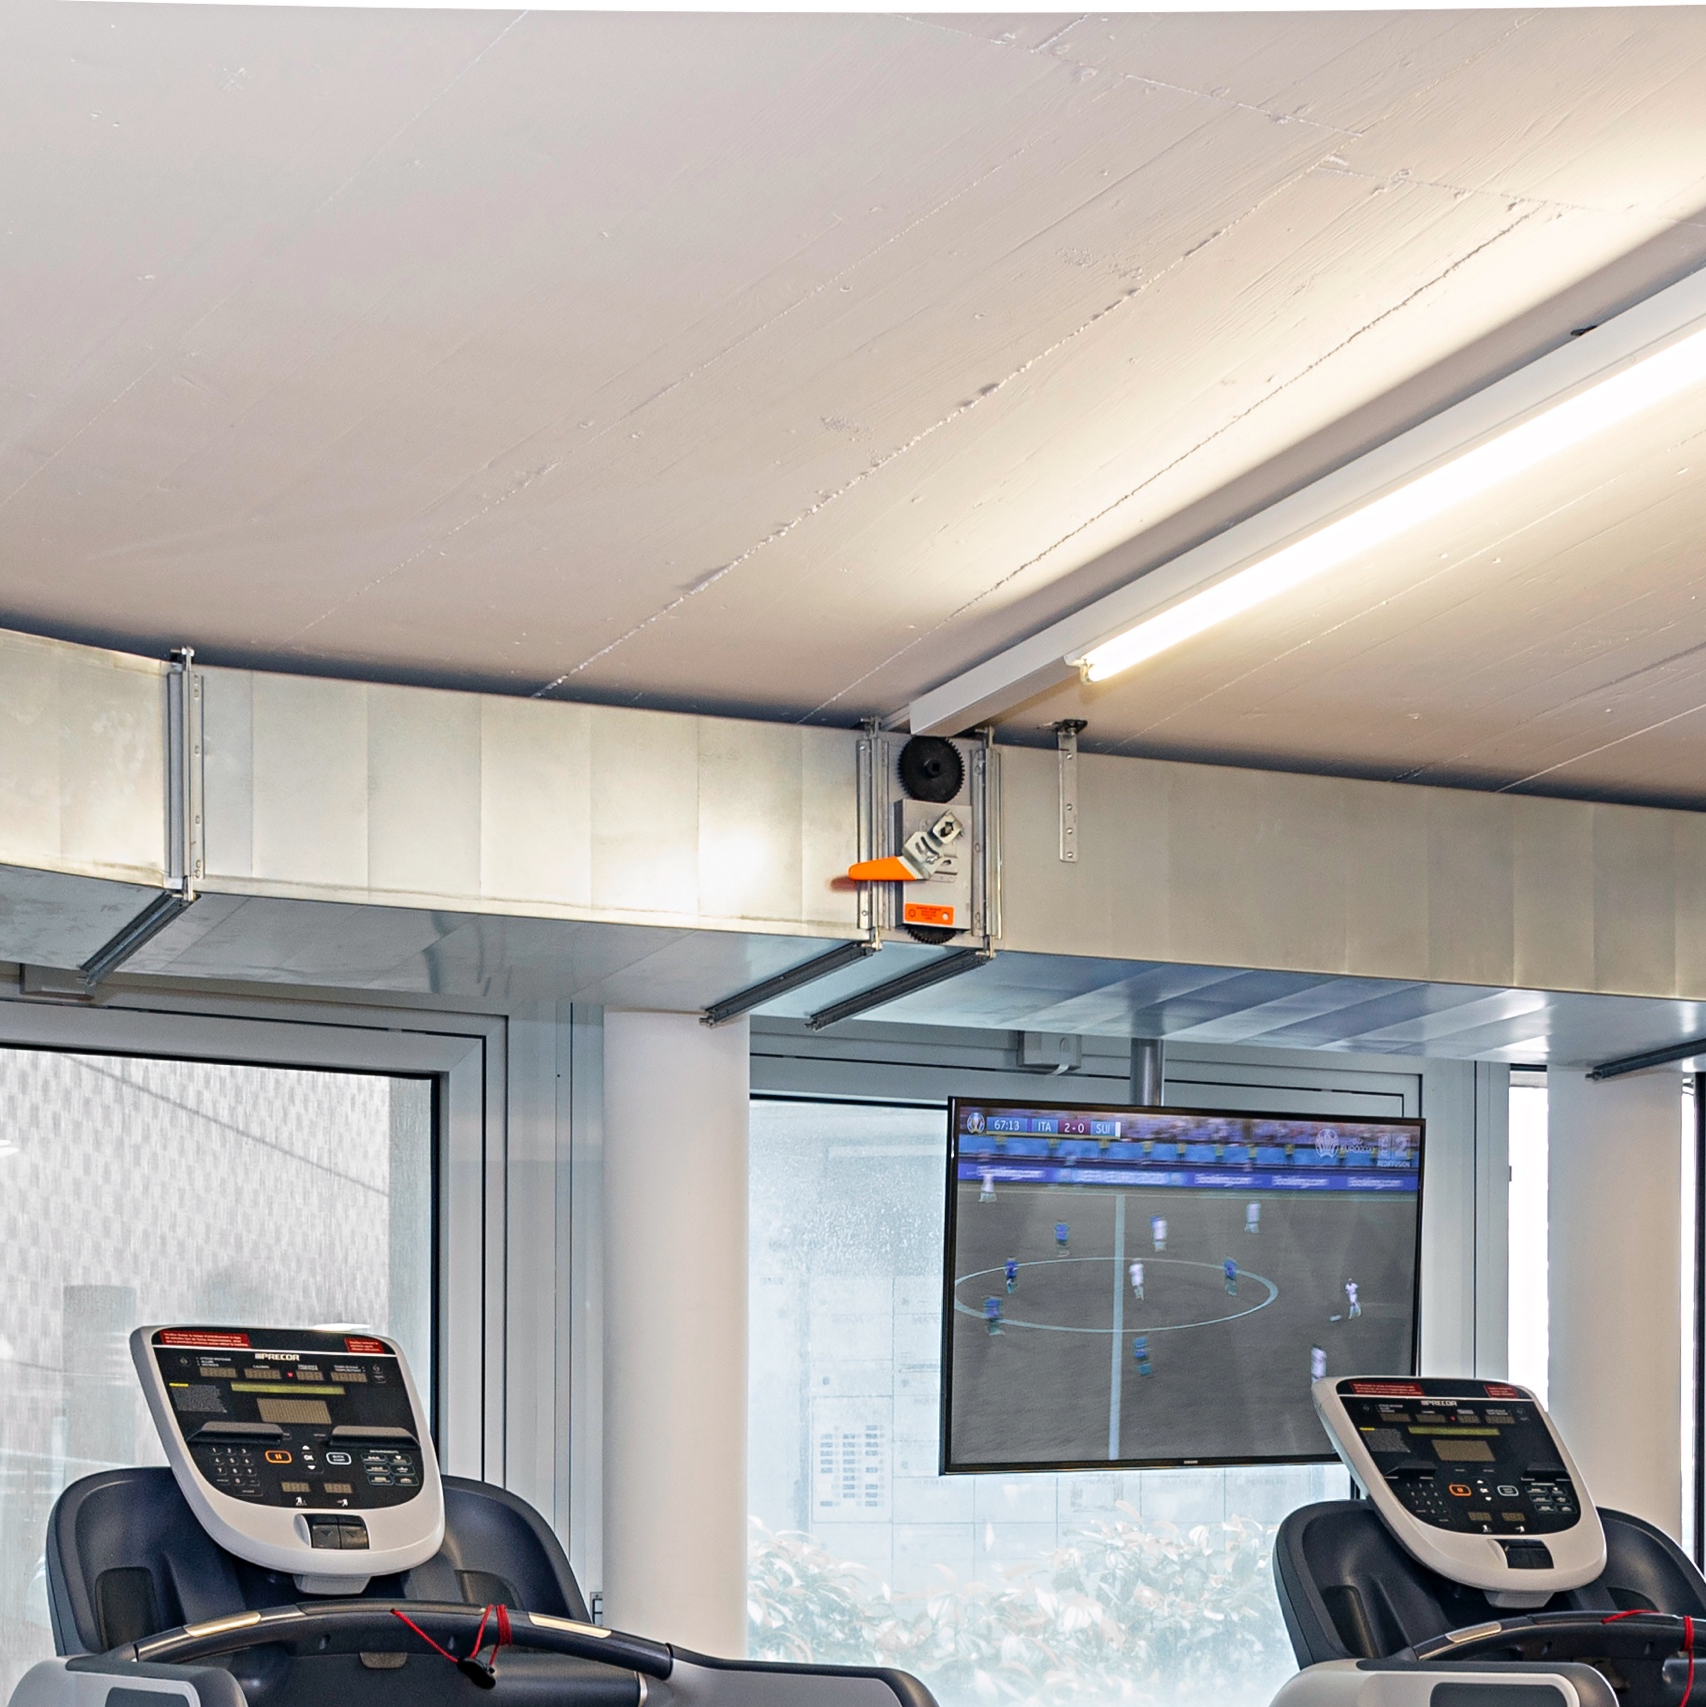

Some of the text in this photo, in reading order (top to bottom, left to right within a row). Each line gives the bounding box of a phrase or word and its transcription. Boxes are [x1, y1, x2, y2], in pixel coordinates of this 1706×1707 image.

[994, 1120, 1020, 1131] 67:13
[1037, 1120, 1052, 1132] ITA
[1096, 1123, 1111, 1135] SUI
[260, 1353, 300, 1361] PRECOR
